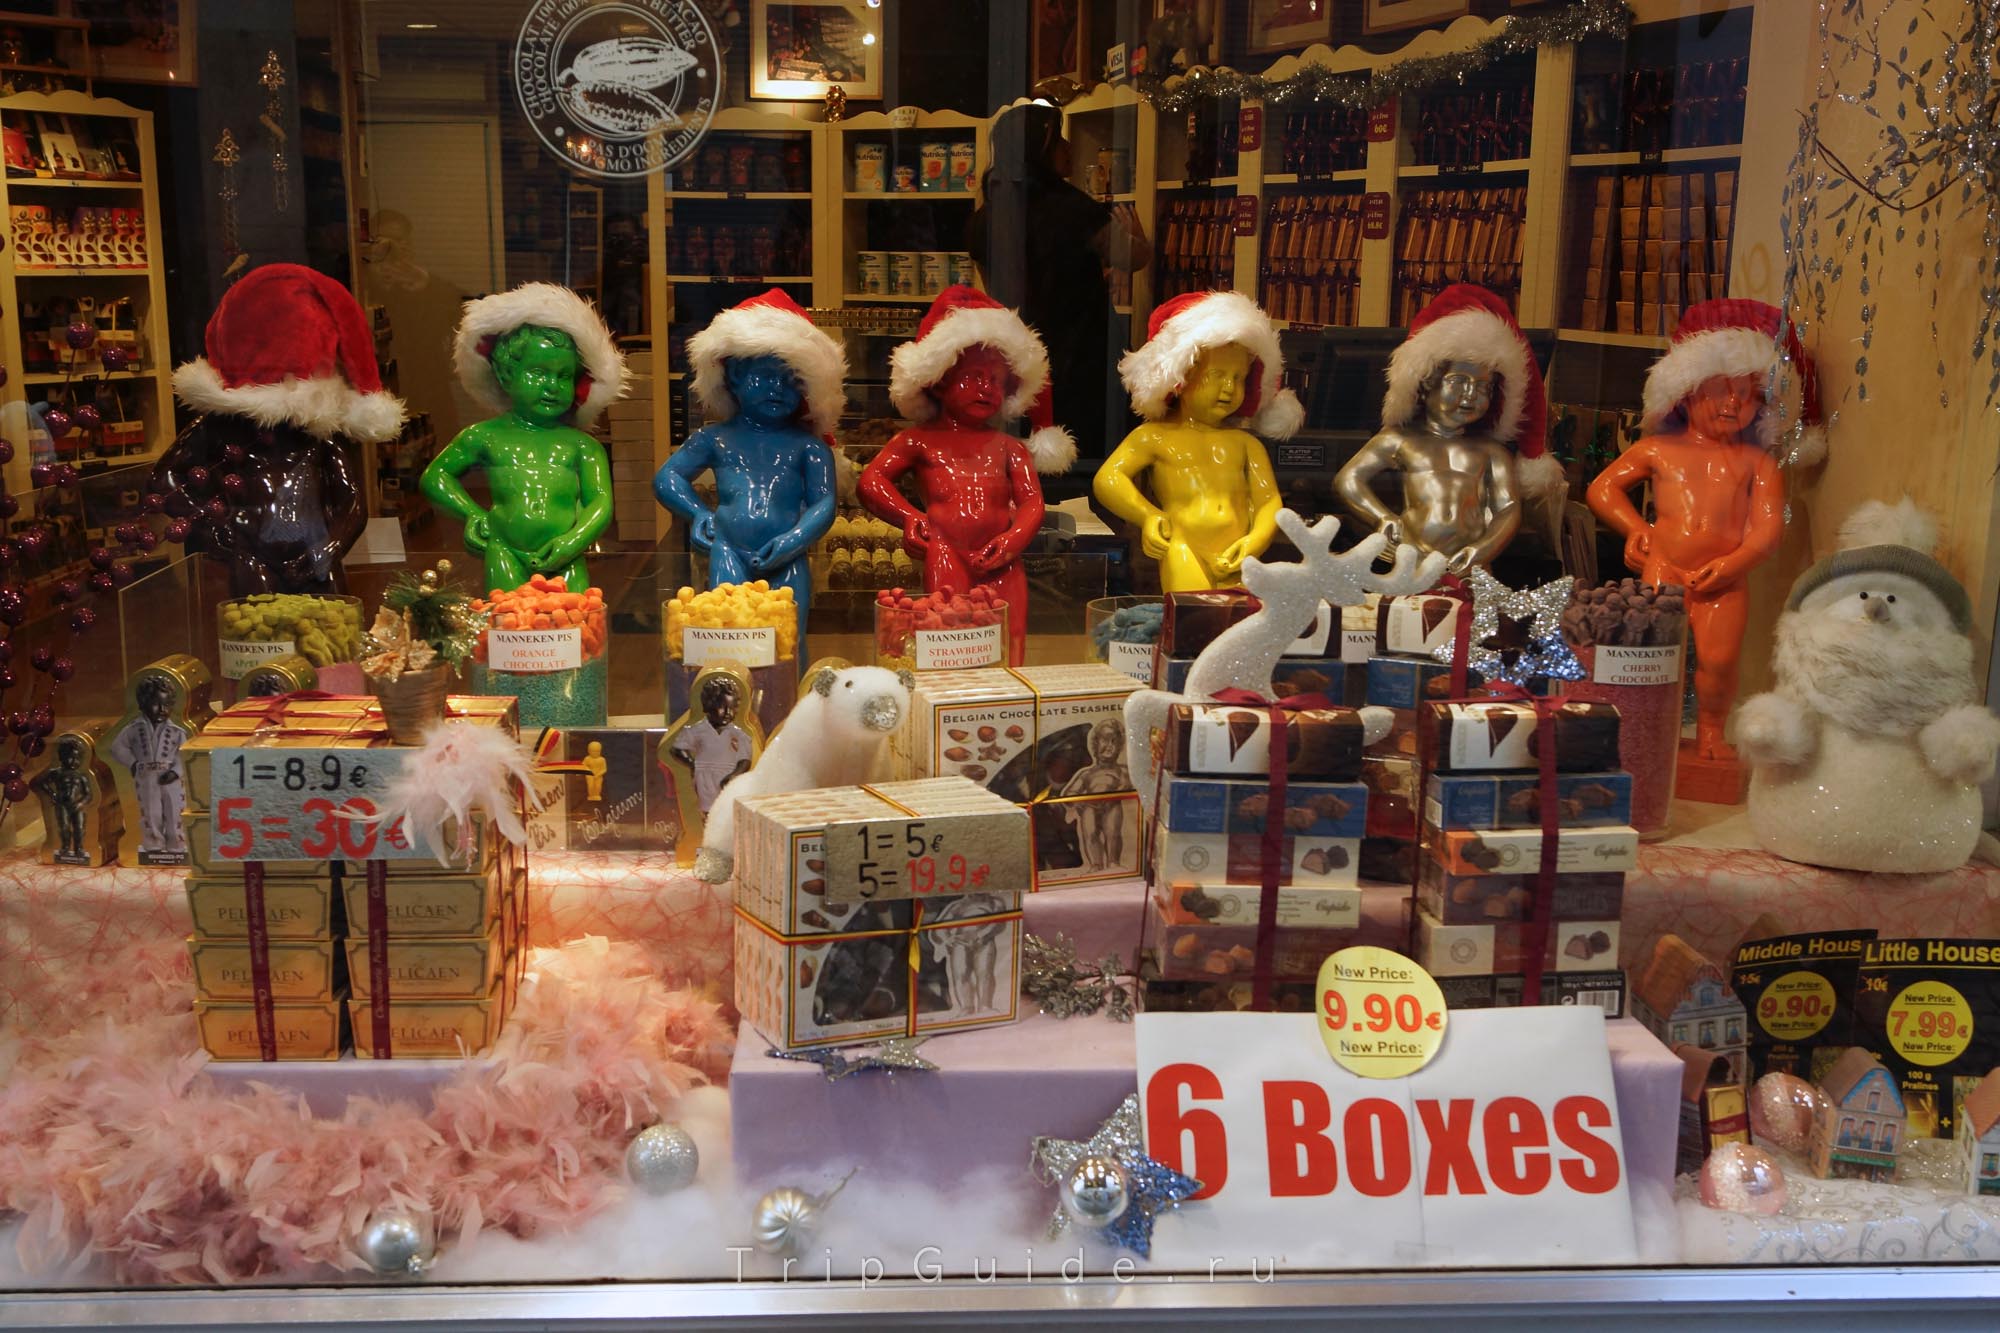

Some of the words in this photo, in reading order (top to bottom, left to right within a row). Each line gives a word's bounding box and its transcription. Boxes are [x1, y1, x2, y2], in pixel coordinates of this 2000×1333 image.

[532, 19, 561, 114] CHOCOLATE
[649, 0, 697, 51] BUTTER
[520, 24, 545, 120] CHOCOLAT
[593, 152, 631, 172] GMO
[635, 96, 712, 169] INGREDIENTS
[588, 138, 615, 158] PAS
[496, 634, 555, 644] MANNEKEN
[557, 632, 572, 642] PIS
[692, 631, 750, 641] MANNEKEN
[752, 631, 767, 640] PIS
[926, 631, 983, 642] MANNEKEN
[984, 629, 996, 639] PIS
[267, 645, 284, 654] PIS
[512, 648, 557, 658] ORANGE
[929, 643, 992, 657] STRAWBERRY
[1607, 649, 1663, 659] MANNEKEN
[1664, 648, 1676, 657] PIS
[503, 659, 568, 669] CHOCOLATE
[932, 654, 992, 668] CHOCOLATE
[1622, 664, 1662, 673] CHERRY
[1611, 674, 1669, 684] CHOCOLATE
[943, 712, 995, 724] BELGIAN
[577, 791, 643, 844] Belgium
[218, 908, 302, 920] PELAEN
[386, 904, 458, 916] ELICAEN
[1738, 941, 1803, 963] Middle
[1808, 938, 1862, 955] Hous
[1865, 941, 1920, 963] Little
[1926, 941, 2000, 963] House
[222, 969, 304, 981] PELAEN
[388, 967, 460, 978] ELICAEN
[1333, 963, 1365, 978] New
[1369, 966, 1414, 980] Price:
[1904, 994, 1925, 1003] New
[1927, 993, 1956, 1003] Price:
[1323, 989, 1442, 1033] 9.90€
[1760, 995, 1832, 1019] 9.90€
[1890, 1010, 1969, 1039] 7.99€
[228, 1030, 310, 1042] PELAEN
[391, 1028, 463, 1039] ELICAEN
[1340, 1039, 1373, 1053] New
[1377, 1041, 1423, 1054] Price:
[1903, 1042, 1924, 1051] New
[1926, 1042, 1956, 1051] Price:
[1902, 1080, 1939, 1091] Pralines
[1146, 1063, 1229, 1201] 6
[1262, 1079, 1621, 1198] Boxes
